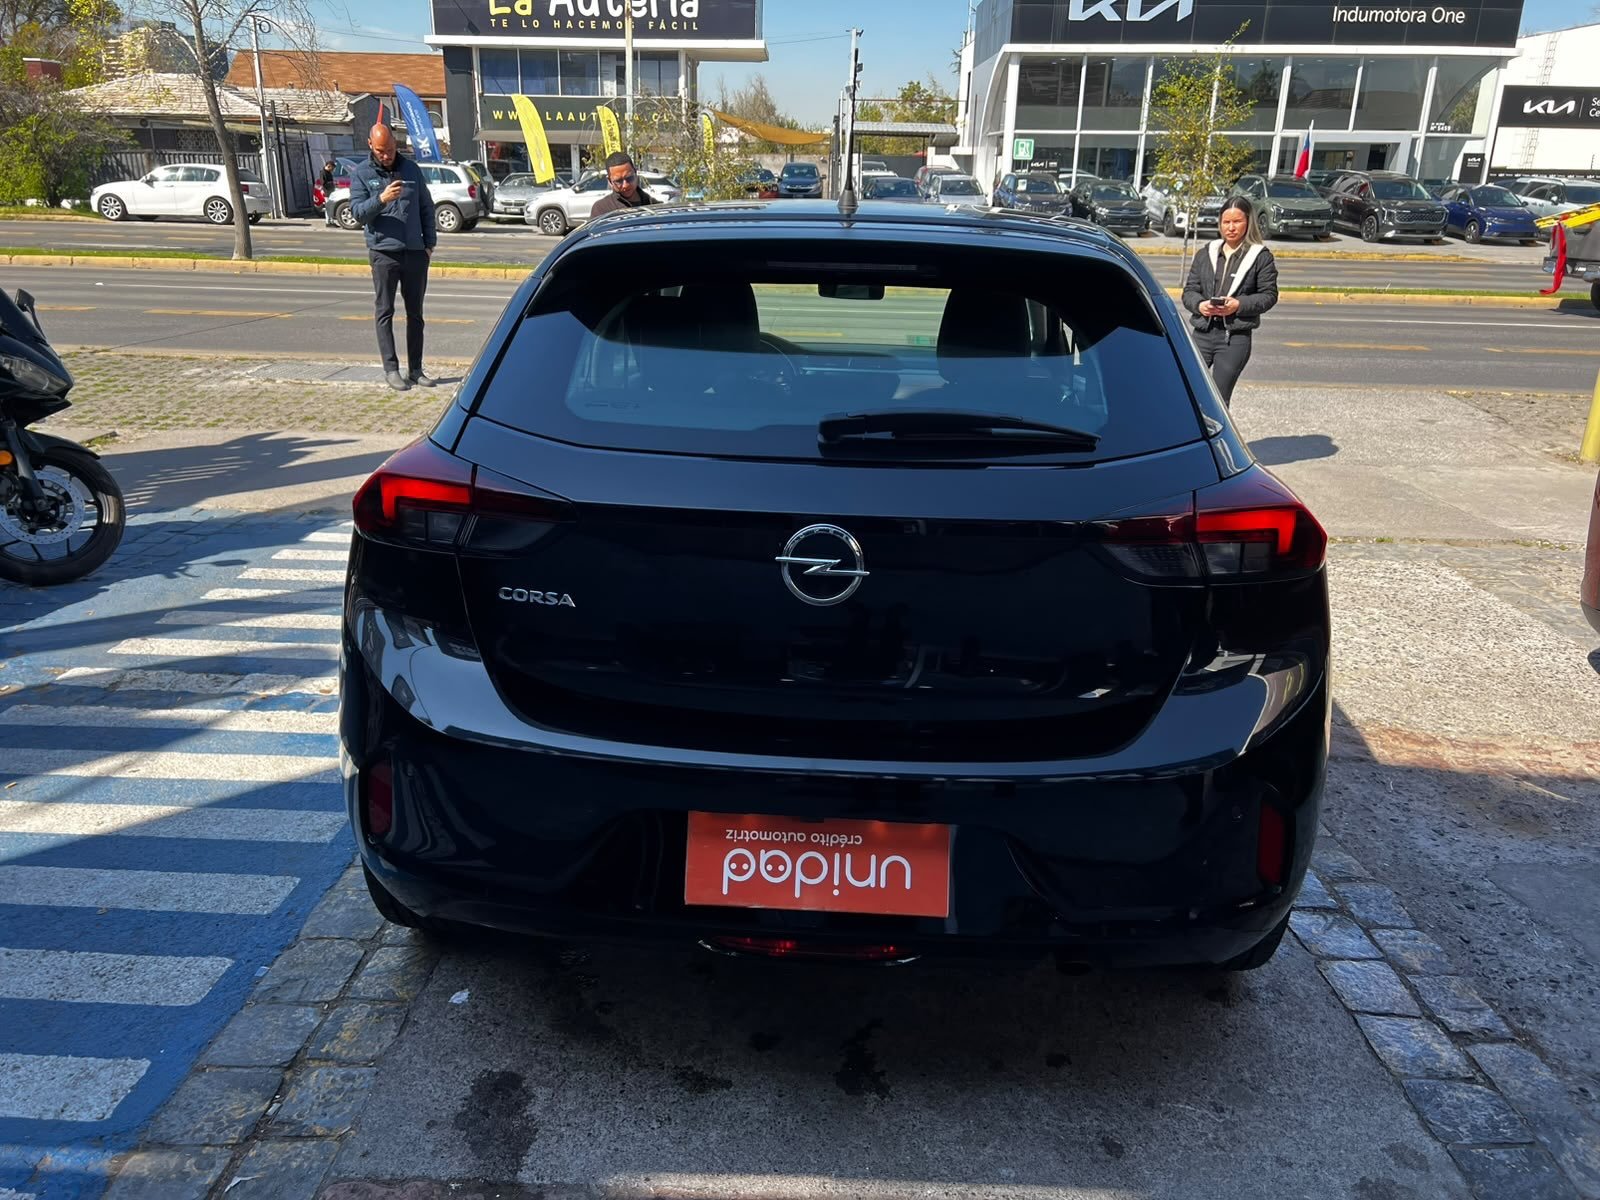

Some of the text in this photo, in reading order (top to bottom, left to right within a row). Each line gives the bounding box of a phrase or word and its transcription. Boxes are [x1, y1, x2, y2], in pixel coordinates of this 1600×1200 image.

[489, 0, 532, 16] La
[1068, 0, 1193, 21] KIA
[1333, 6, 1466, 23] Indumotora One
[490, 19, 508, 28] TE
[522, 19, 540, 28] LO
[648, 19, 698, 30] FÁCIL
[1522, 99, 1576, 114] KIA
[498, 586, 577, 608] CORSA
[725, 829, 863, 848] crédito automotriz
[721, 847, 912, 899] unidad
